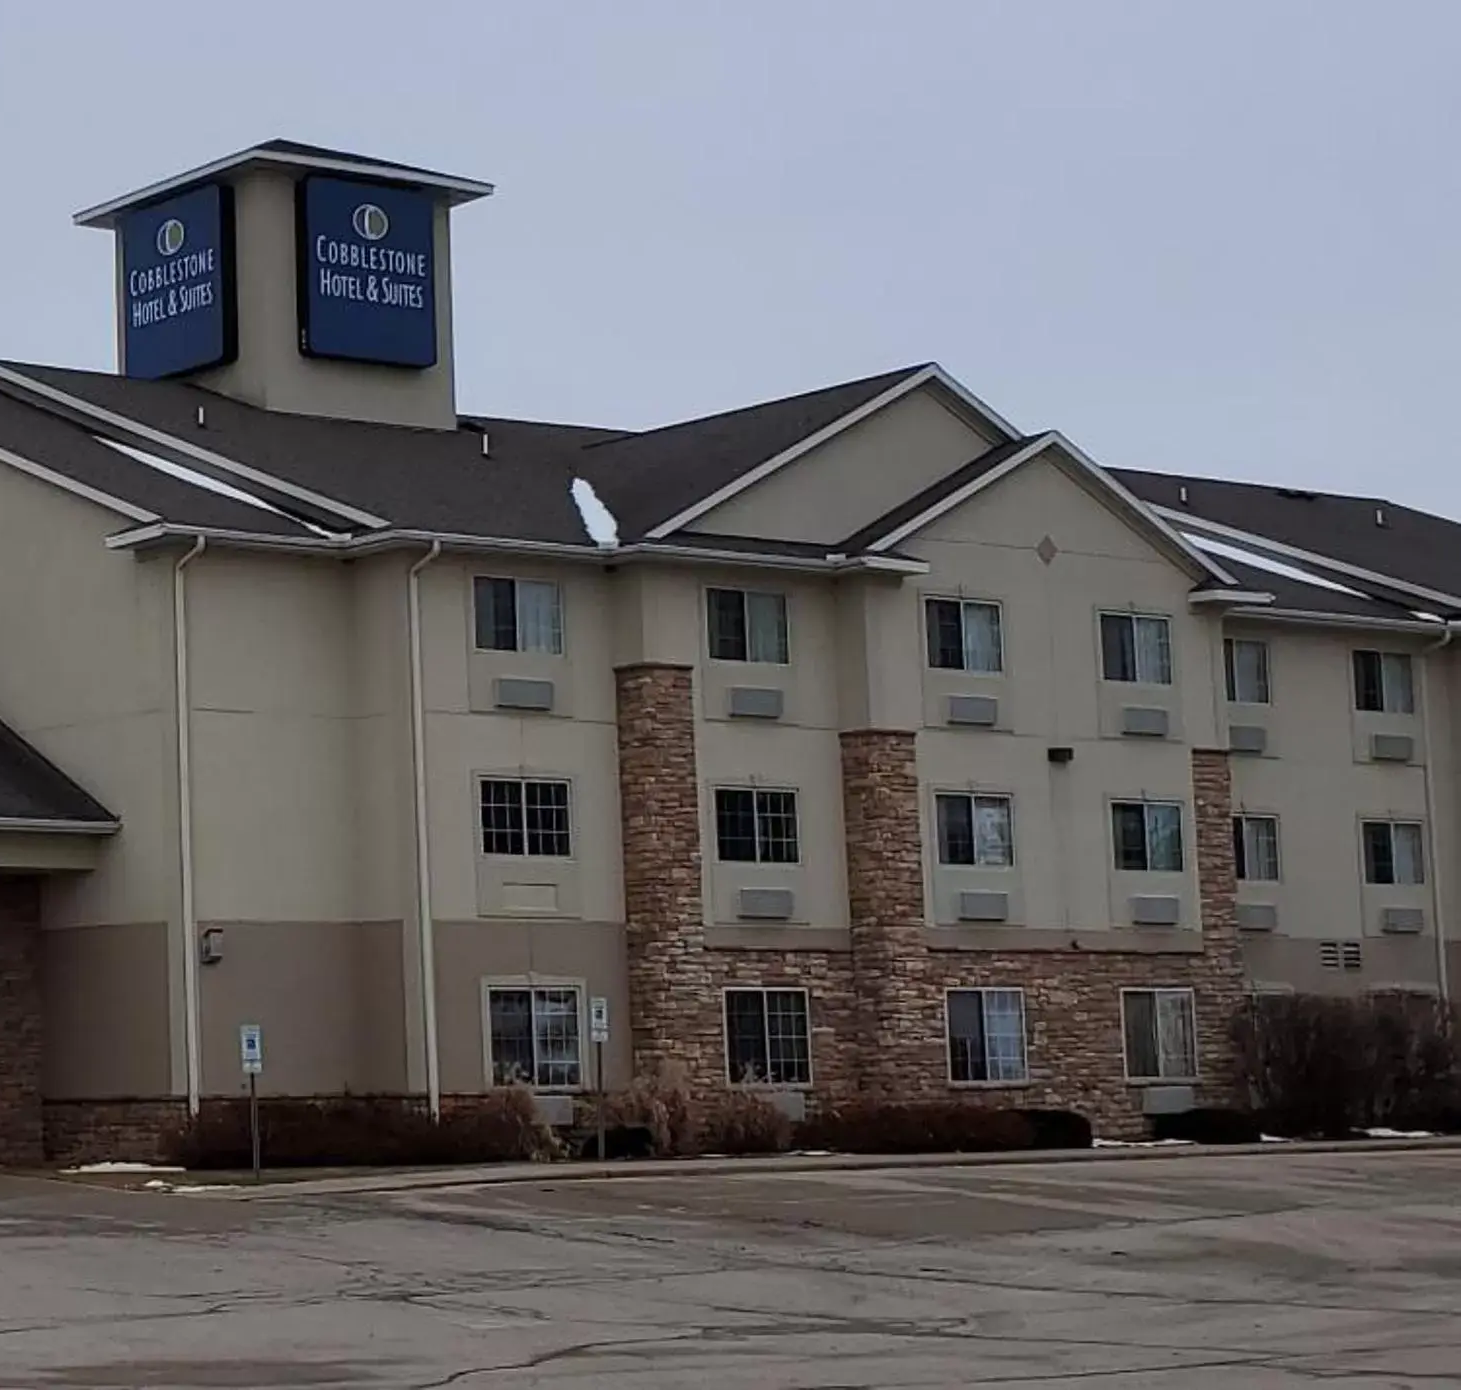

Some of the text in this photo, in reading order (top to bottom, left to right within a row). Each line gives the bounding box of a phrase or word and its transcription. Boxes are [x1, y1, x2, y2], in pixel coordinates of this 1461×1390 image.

[130, 248, 214, 296] COBBLESTONE
[317, 235, 426, 277] COBBLESTONE
[132, 281, 213, 328] HOTEL & SUITES
[320, 268, 424, 308] HOTEL & SUITES
